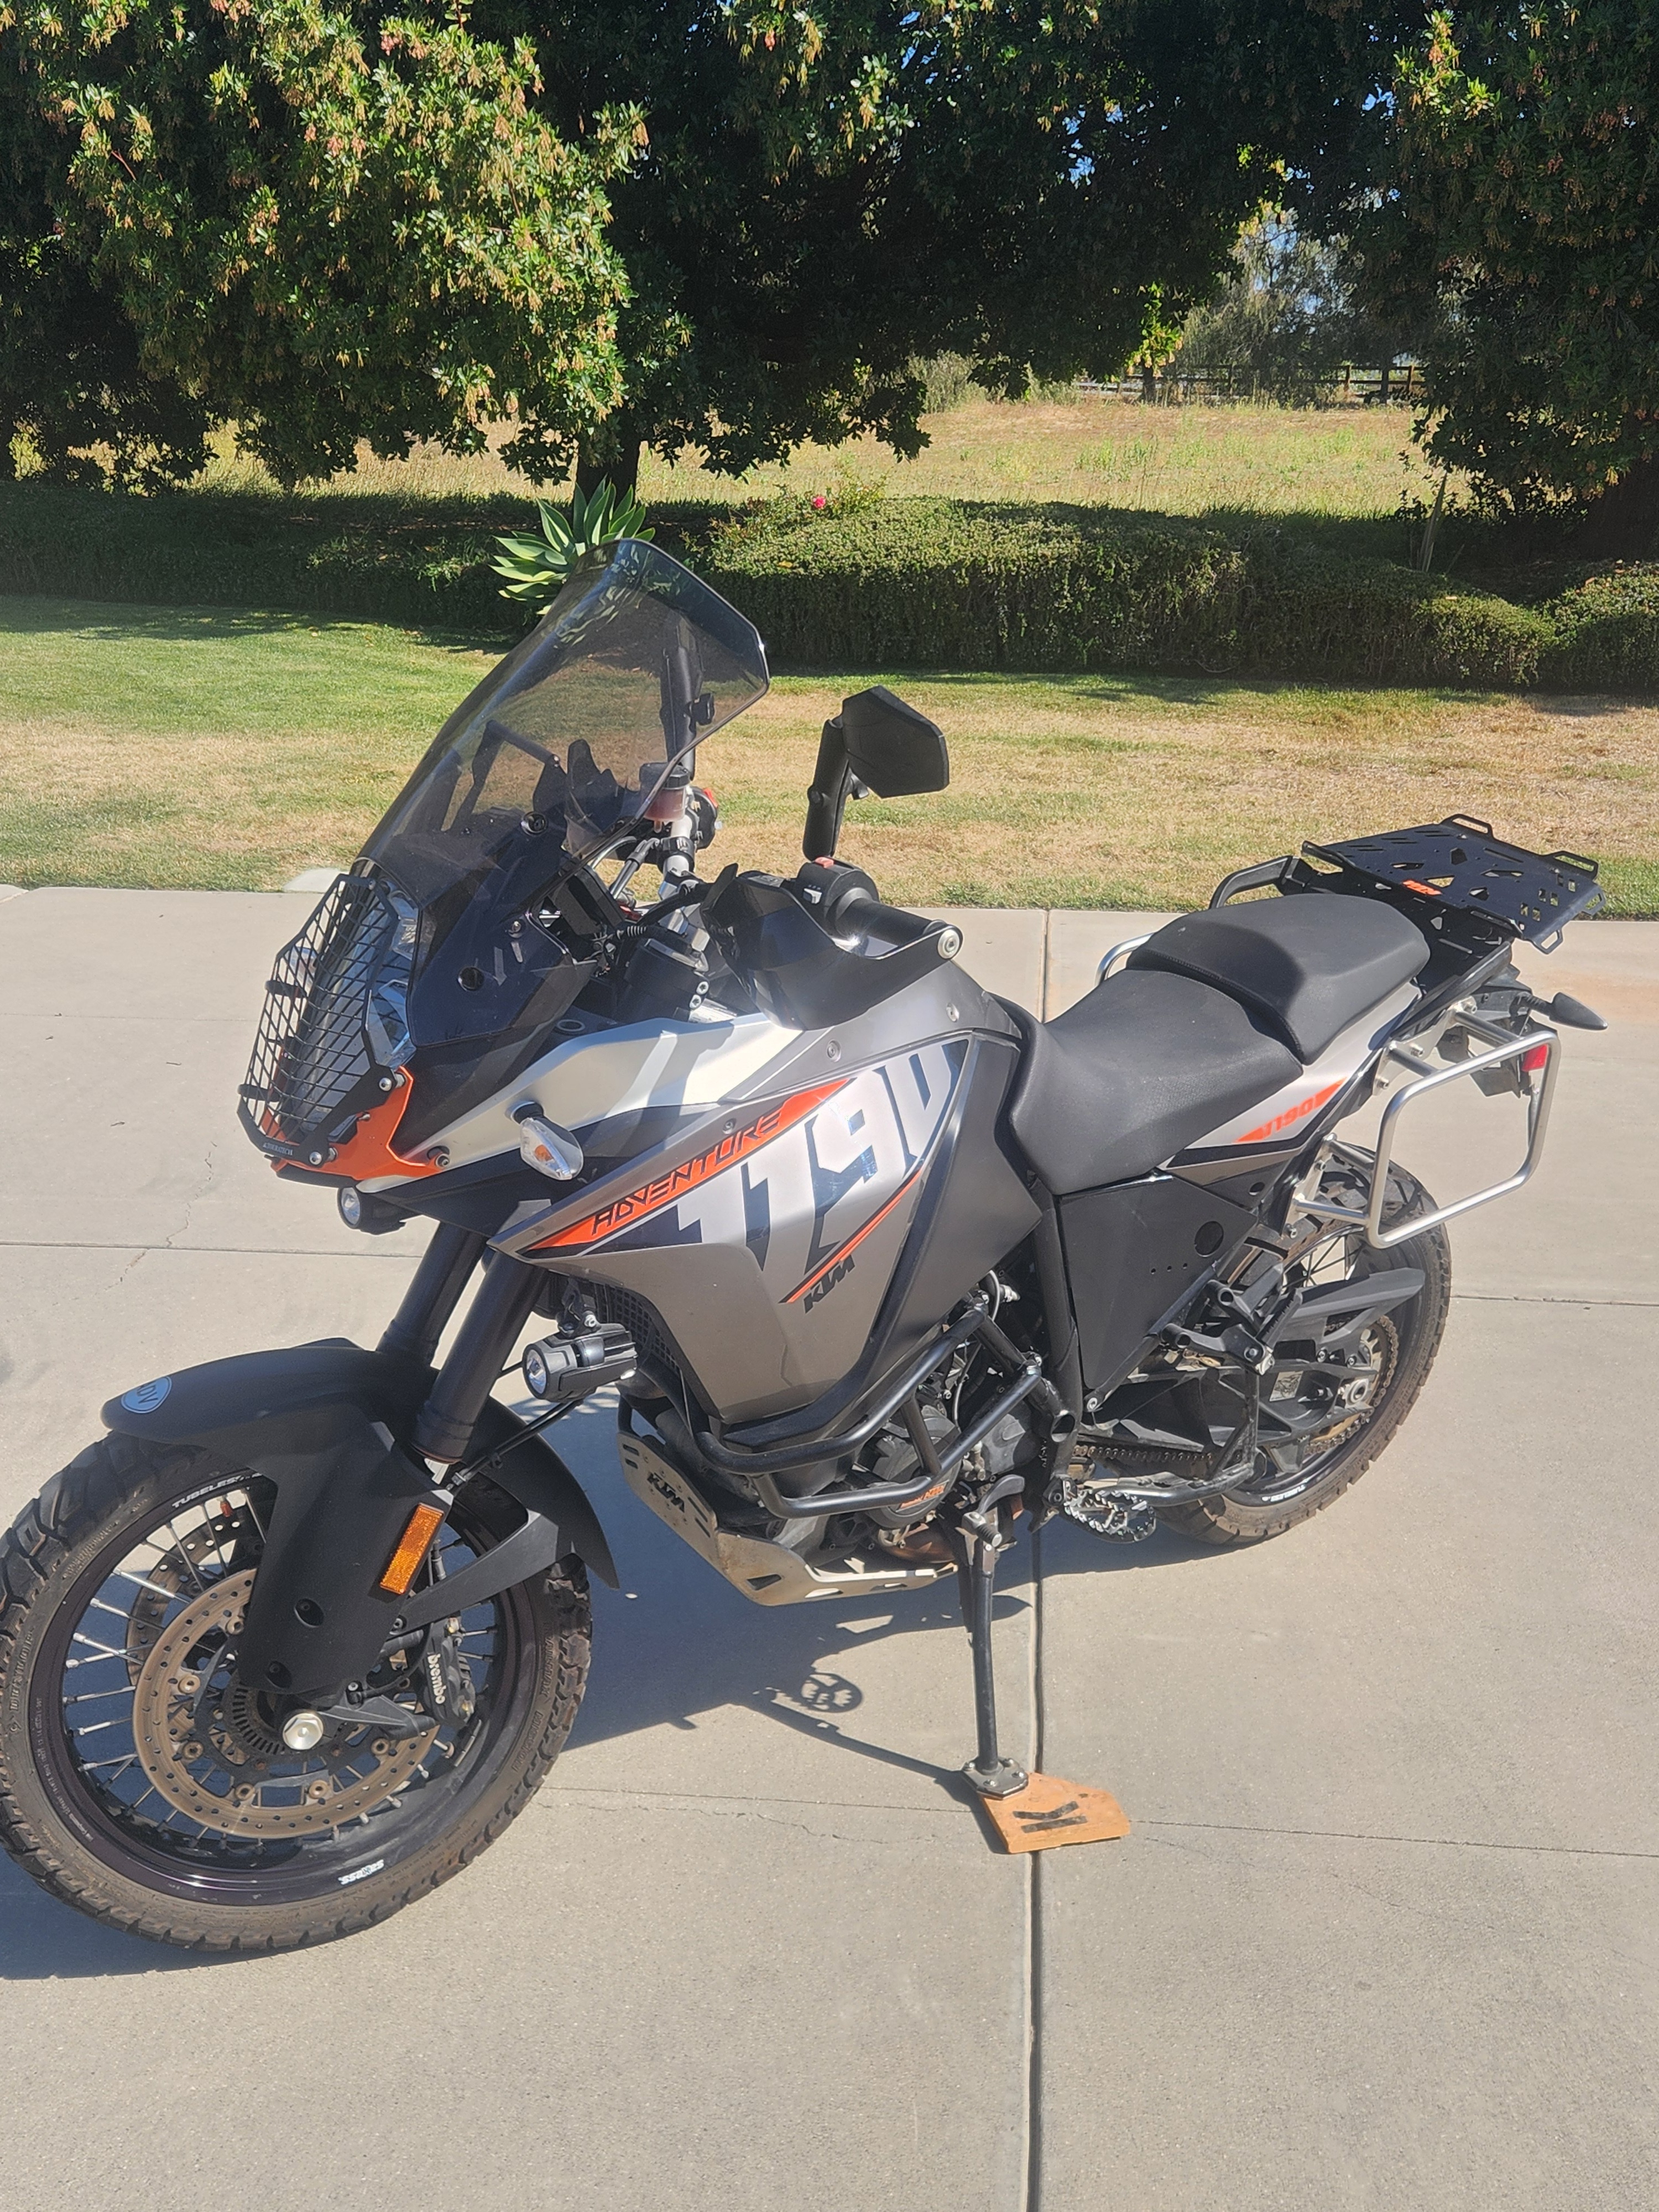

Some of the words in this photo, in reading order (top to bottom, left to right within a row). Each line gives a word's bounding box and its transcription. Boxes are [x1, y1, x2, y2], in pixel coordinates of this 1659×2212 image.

[1262, 1095, 1315, 1140] 1190
[592, 1114, 781, 1235] ADVENTURE
[678, 1044, 956, 1276] 1190
[804, 1257, 855, 1313] KTM
[136, 1384, 159, 1404] DV
[646, 1472, 685, 1513] KTM
[427, 1653, 446, 1704] brembo
